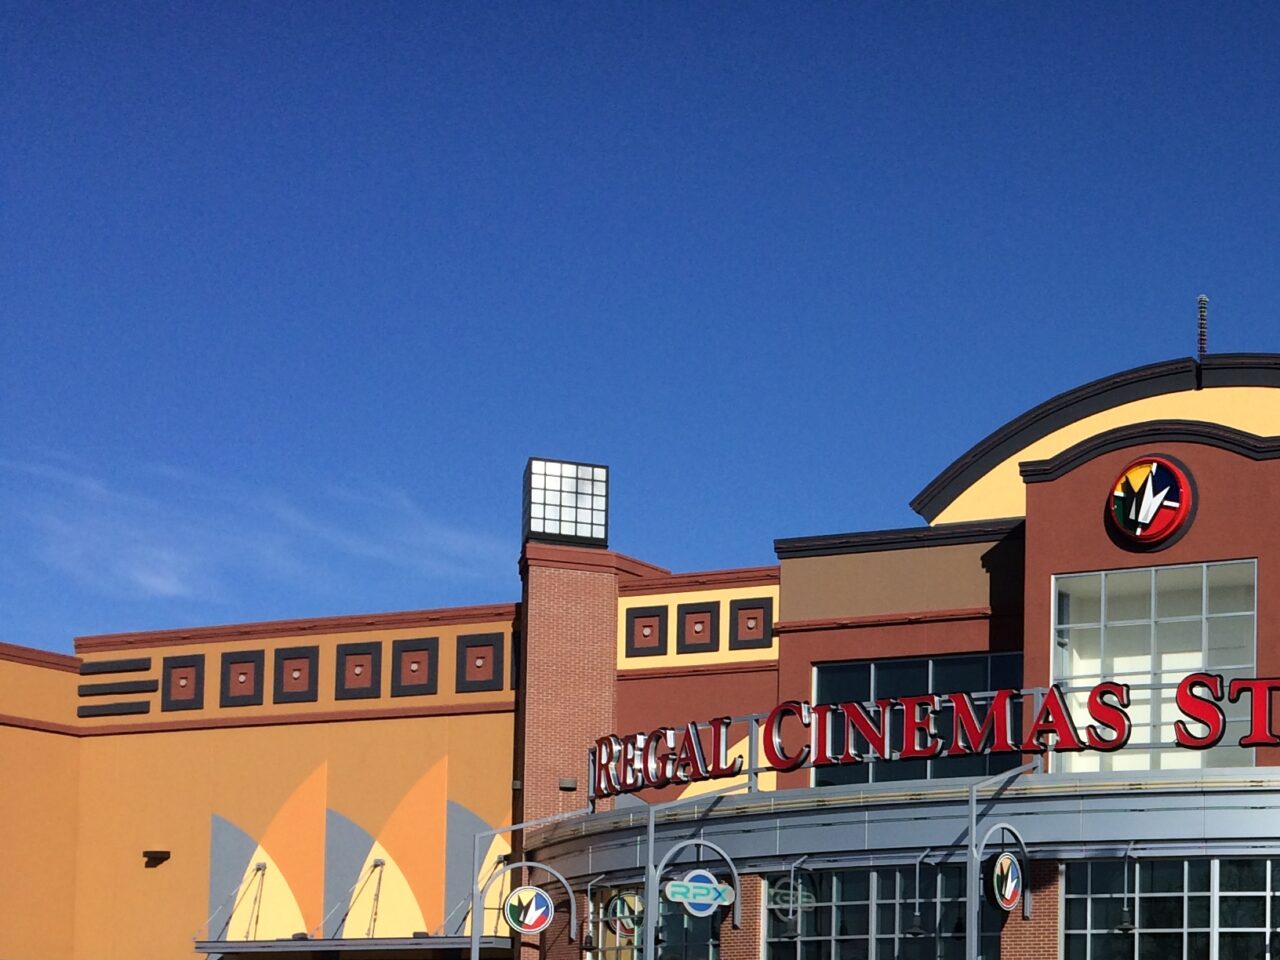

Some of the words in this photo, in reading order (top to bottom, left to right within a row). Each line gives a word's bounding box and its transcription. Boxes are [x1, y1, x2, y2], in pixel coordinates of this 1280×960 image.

[594, 717, 744, 797] REGAL
[762, 681, 1131, 772] CINEMAS
[671, 884, 728, 902] RPX
